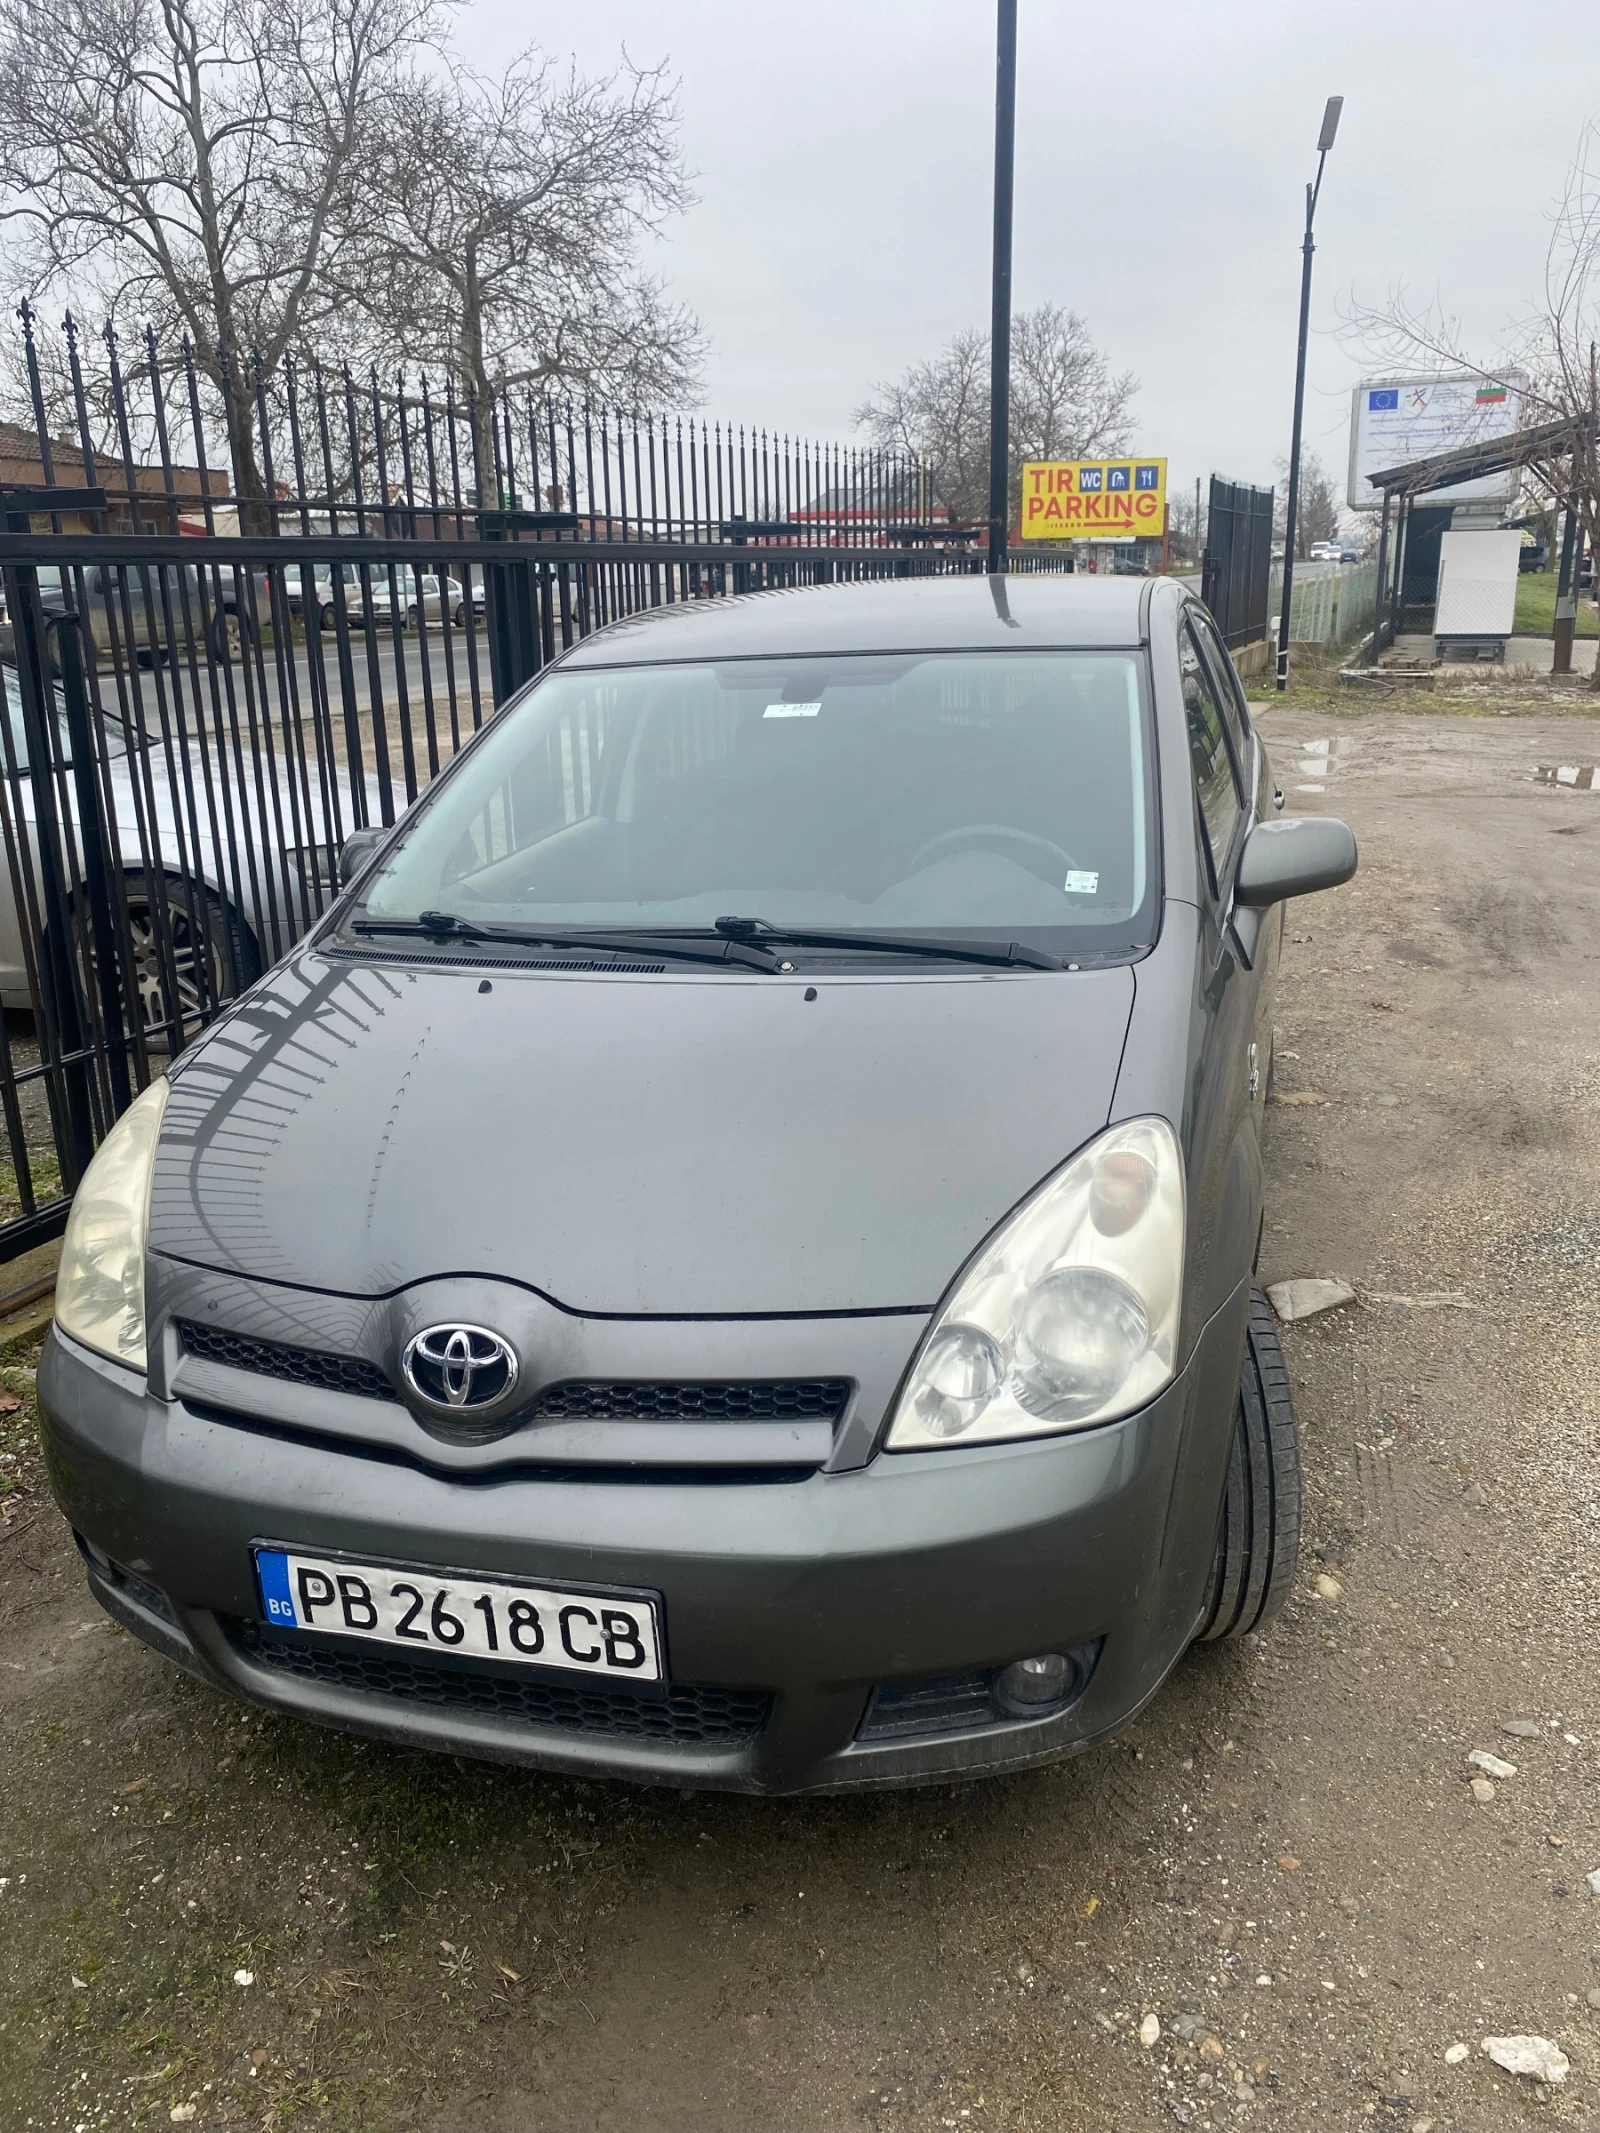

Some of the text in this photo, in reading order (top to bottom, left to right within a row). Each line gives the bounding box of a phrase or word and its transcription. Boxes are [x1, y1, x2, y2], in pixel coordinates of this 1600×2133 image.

[1029, 468, 1102, 494] TIR WC
[1028, 493, 1158, 520] PARKING
[268, 1598, 293, 1617] BG
[297, 1566, 647, 1669] PB 2618 CB
